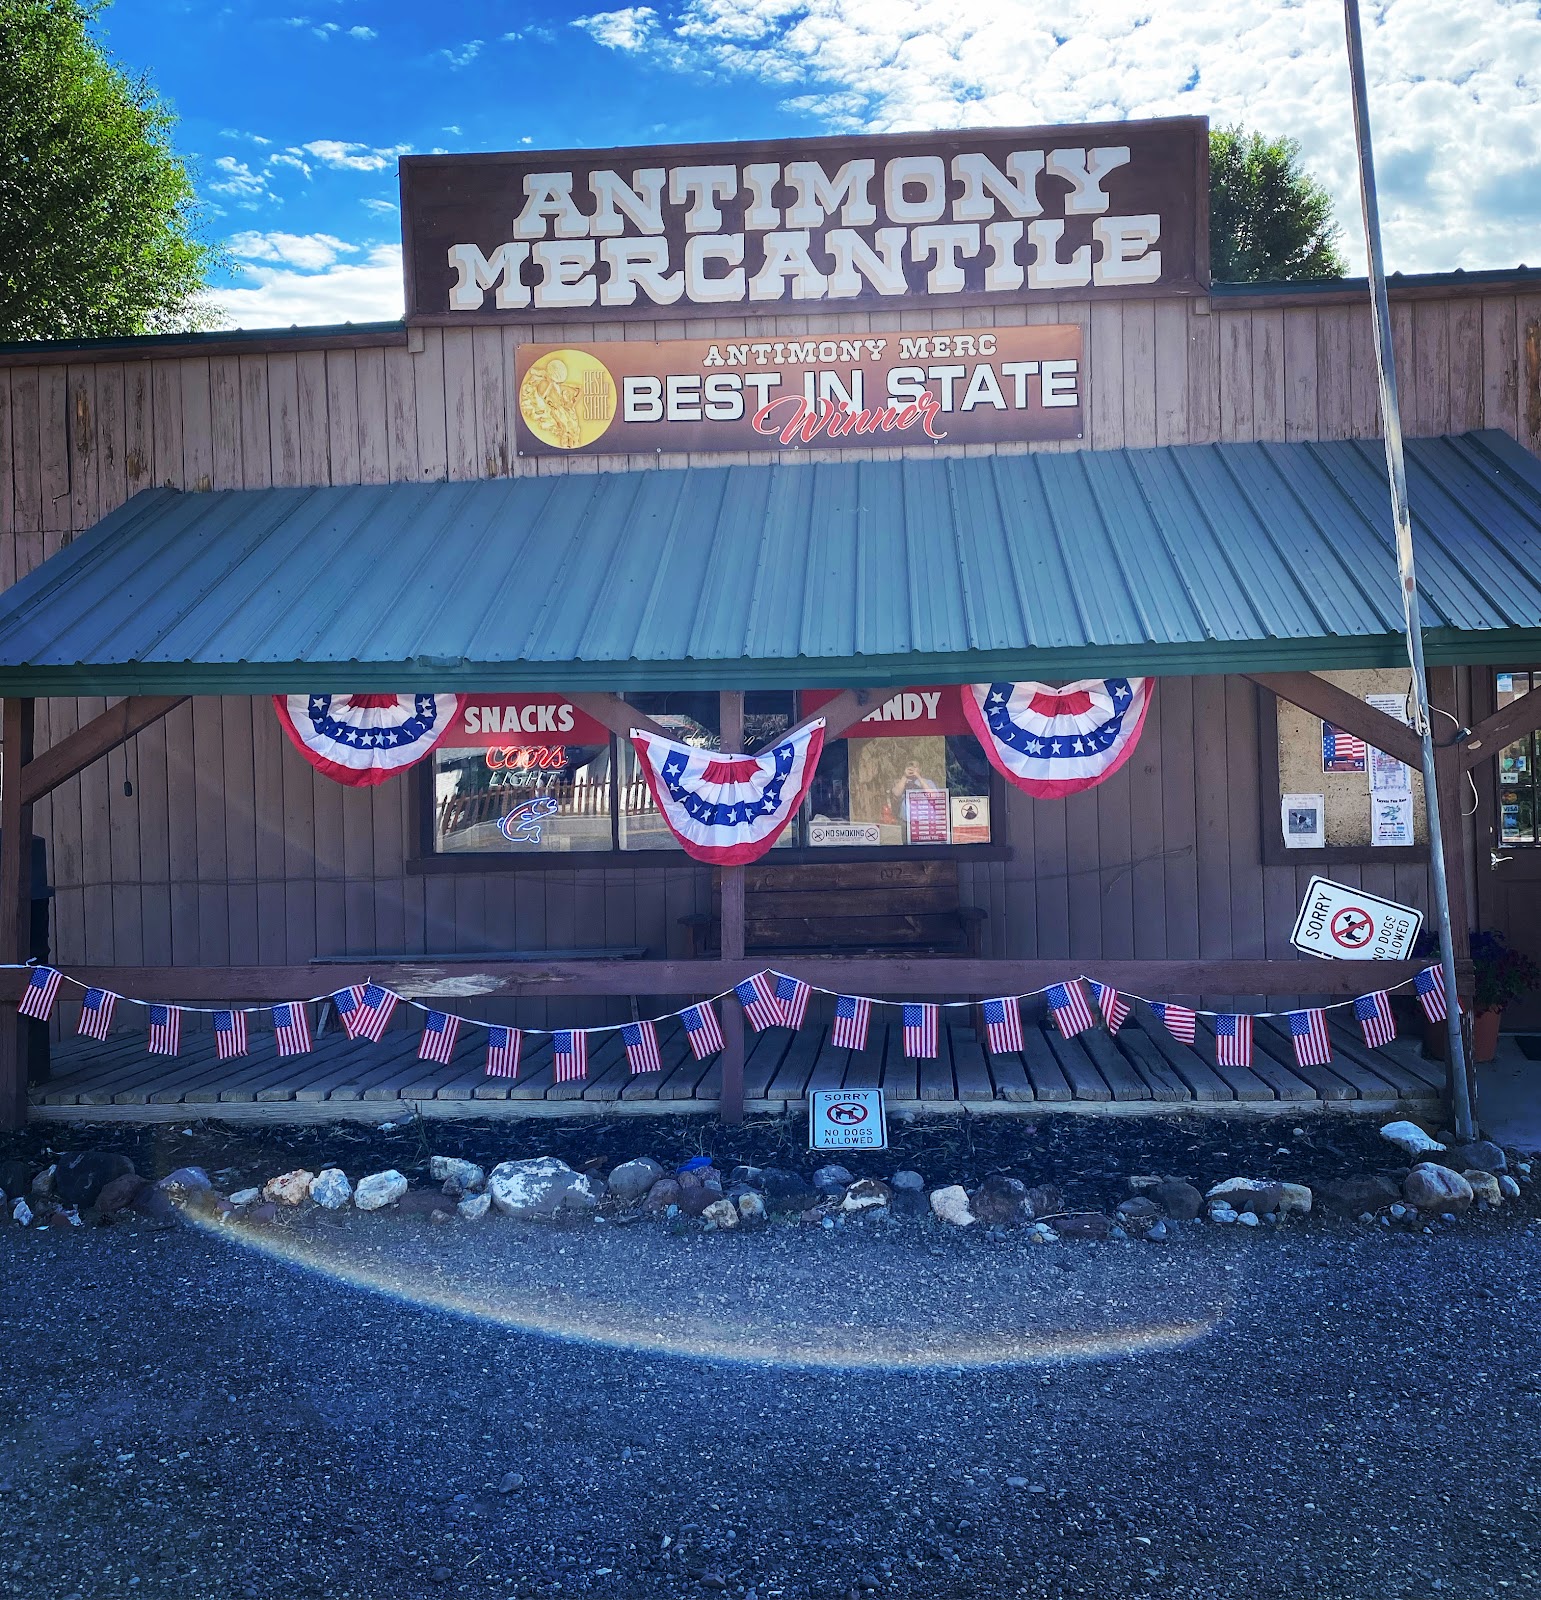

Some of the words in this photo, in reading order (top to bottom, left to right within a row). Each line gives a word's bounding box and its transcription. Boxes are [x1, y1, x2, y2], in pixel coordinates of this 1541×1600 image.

[513, 146, 1131, 239] ANTIMONY
[448, 214, 1162, 310] MERCANTILE
[703, 338, 888, 367] ANTIMONY
[898, 334, 997, 360] MERC
[583, 370, 605, 395] BEST
[623, 372, 782, 423] BEST
[803, 369, 865, 418] IN
[886, 359, 1079, 415] STATE
[583, 394, 610, 421] STATE
[751, 390, 948, 445] Winner
[464, 705, 575, 734] SNACKS
[861, 691, 942, 722] ANDY
[485, 746, 569, 769] Coors
[488, 769, 564, 787] LIGHT
[825, 829, 835, 837] NO
[835, 829, 865, 837] SMOKING
[1305, 892, 1332, 940] SORRY
[1378, 915, 1396, 945] DOGS
[1372, 946, 1386, 960] NO
[824, 1093, 869, 1101] SORRY
[824, 1136, 874, 1145] ALLOWED
[844, 1128, 873, 1136] DOGS
